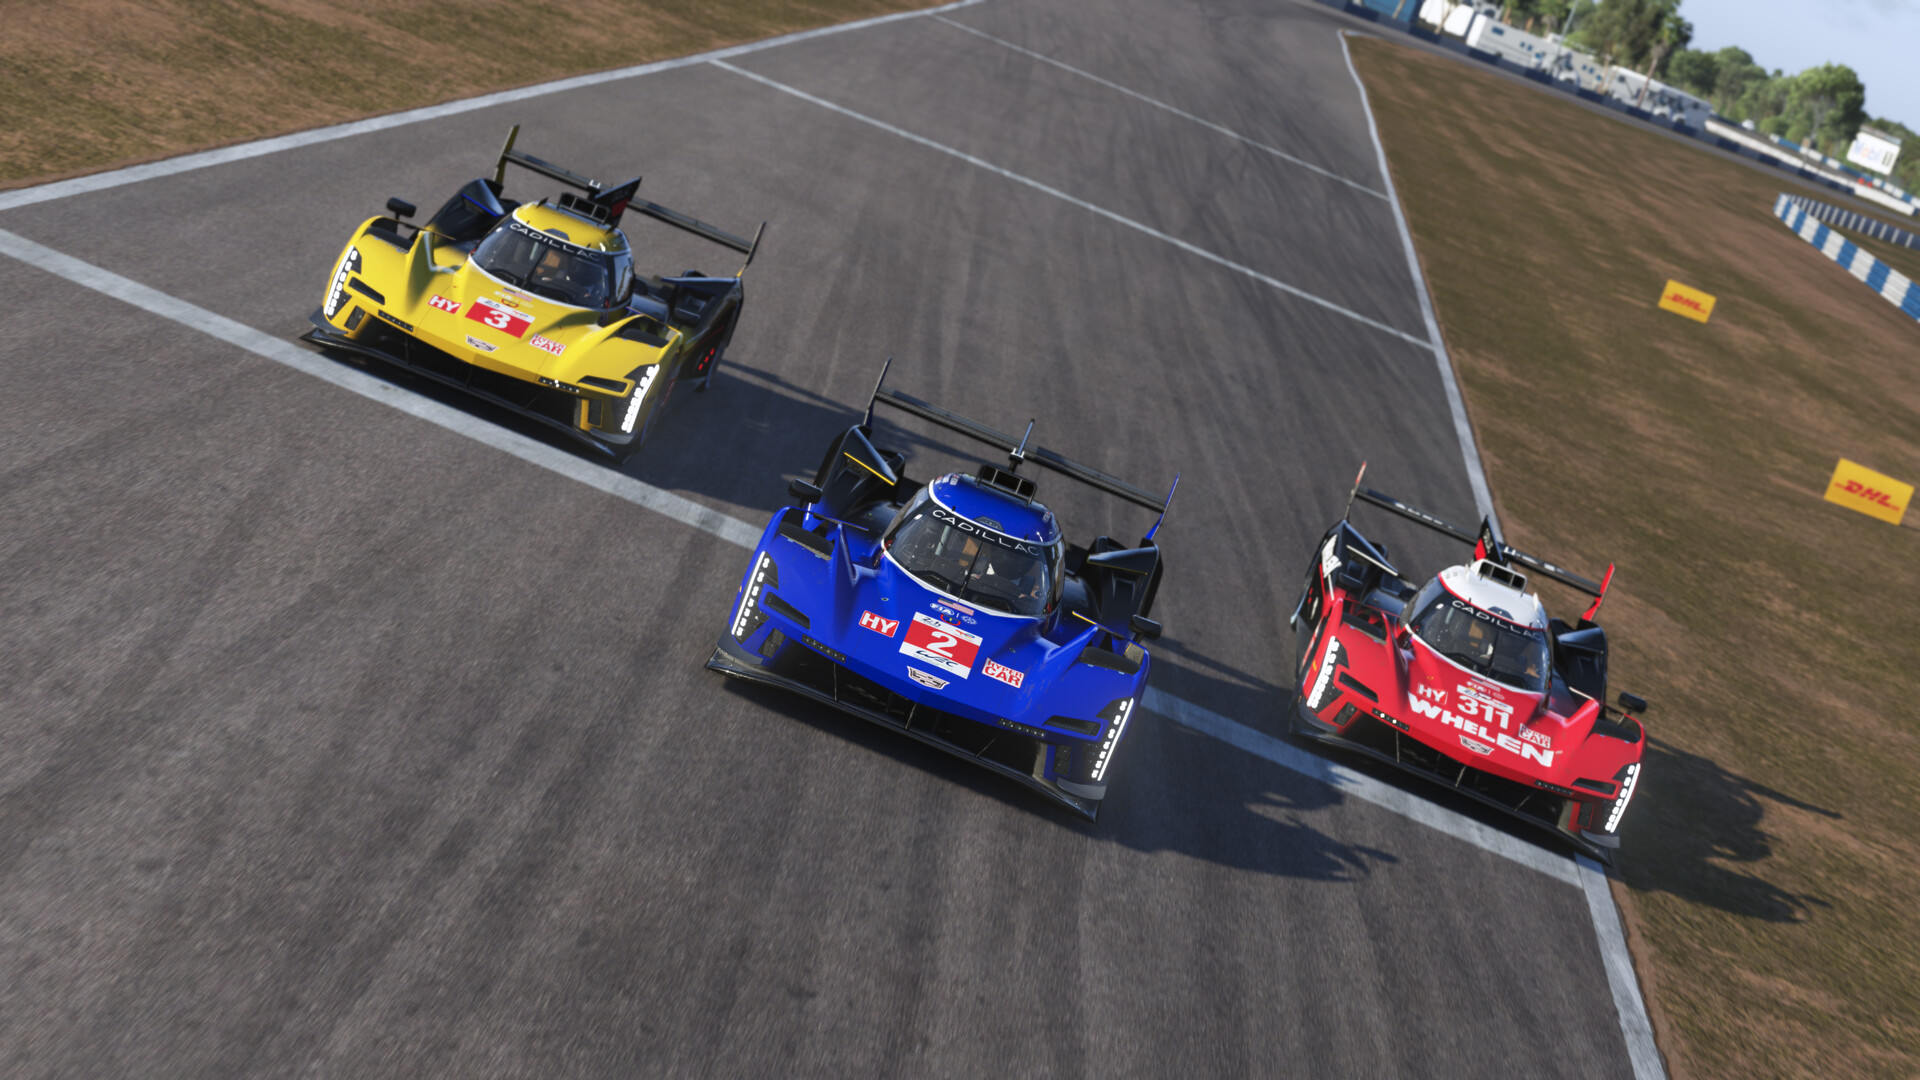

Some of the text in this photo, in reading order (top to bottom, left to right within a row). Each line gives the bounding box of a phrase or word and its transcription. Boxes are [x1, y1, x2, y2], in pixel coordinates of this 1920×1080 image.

[508, 223, 600, 262] CADILLAC
[429, 295, 460, 312] HY
[484, 310, 511, 329] 3
[531, 338, 562, 355] CAR
[1844, 479, 1891, 508] DHL
[932, 509, 1040, 556] CADILLAC
[861, 612, 897, 634] HY
[1452, 600, 1541, 641] CADILLAC
[926, 631, 958, 658] 2
[985, 666, 1020, 686] CAR
[987, 660, 1023, 680] HYPER
[1418, 684, 1446, 703] HY
[1457, 695, 1510, 730] 311
[1408, 691, 1555, 767] WHELEN
